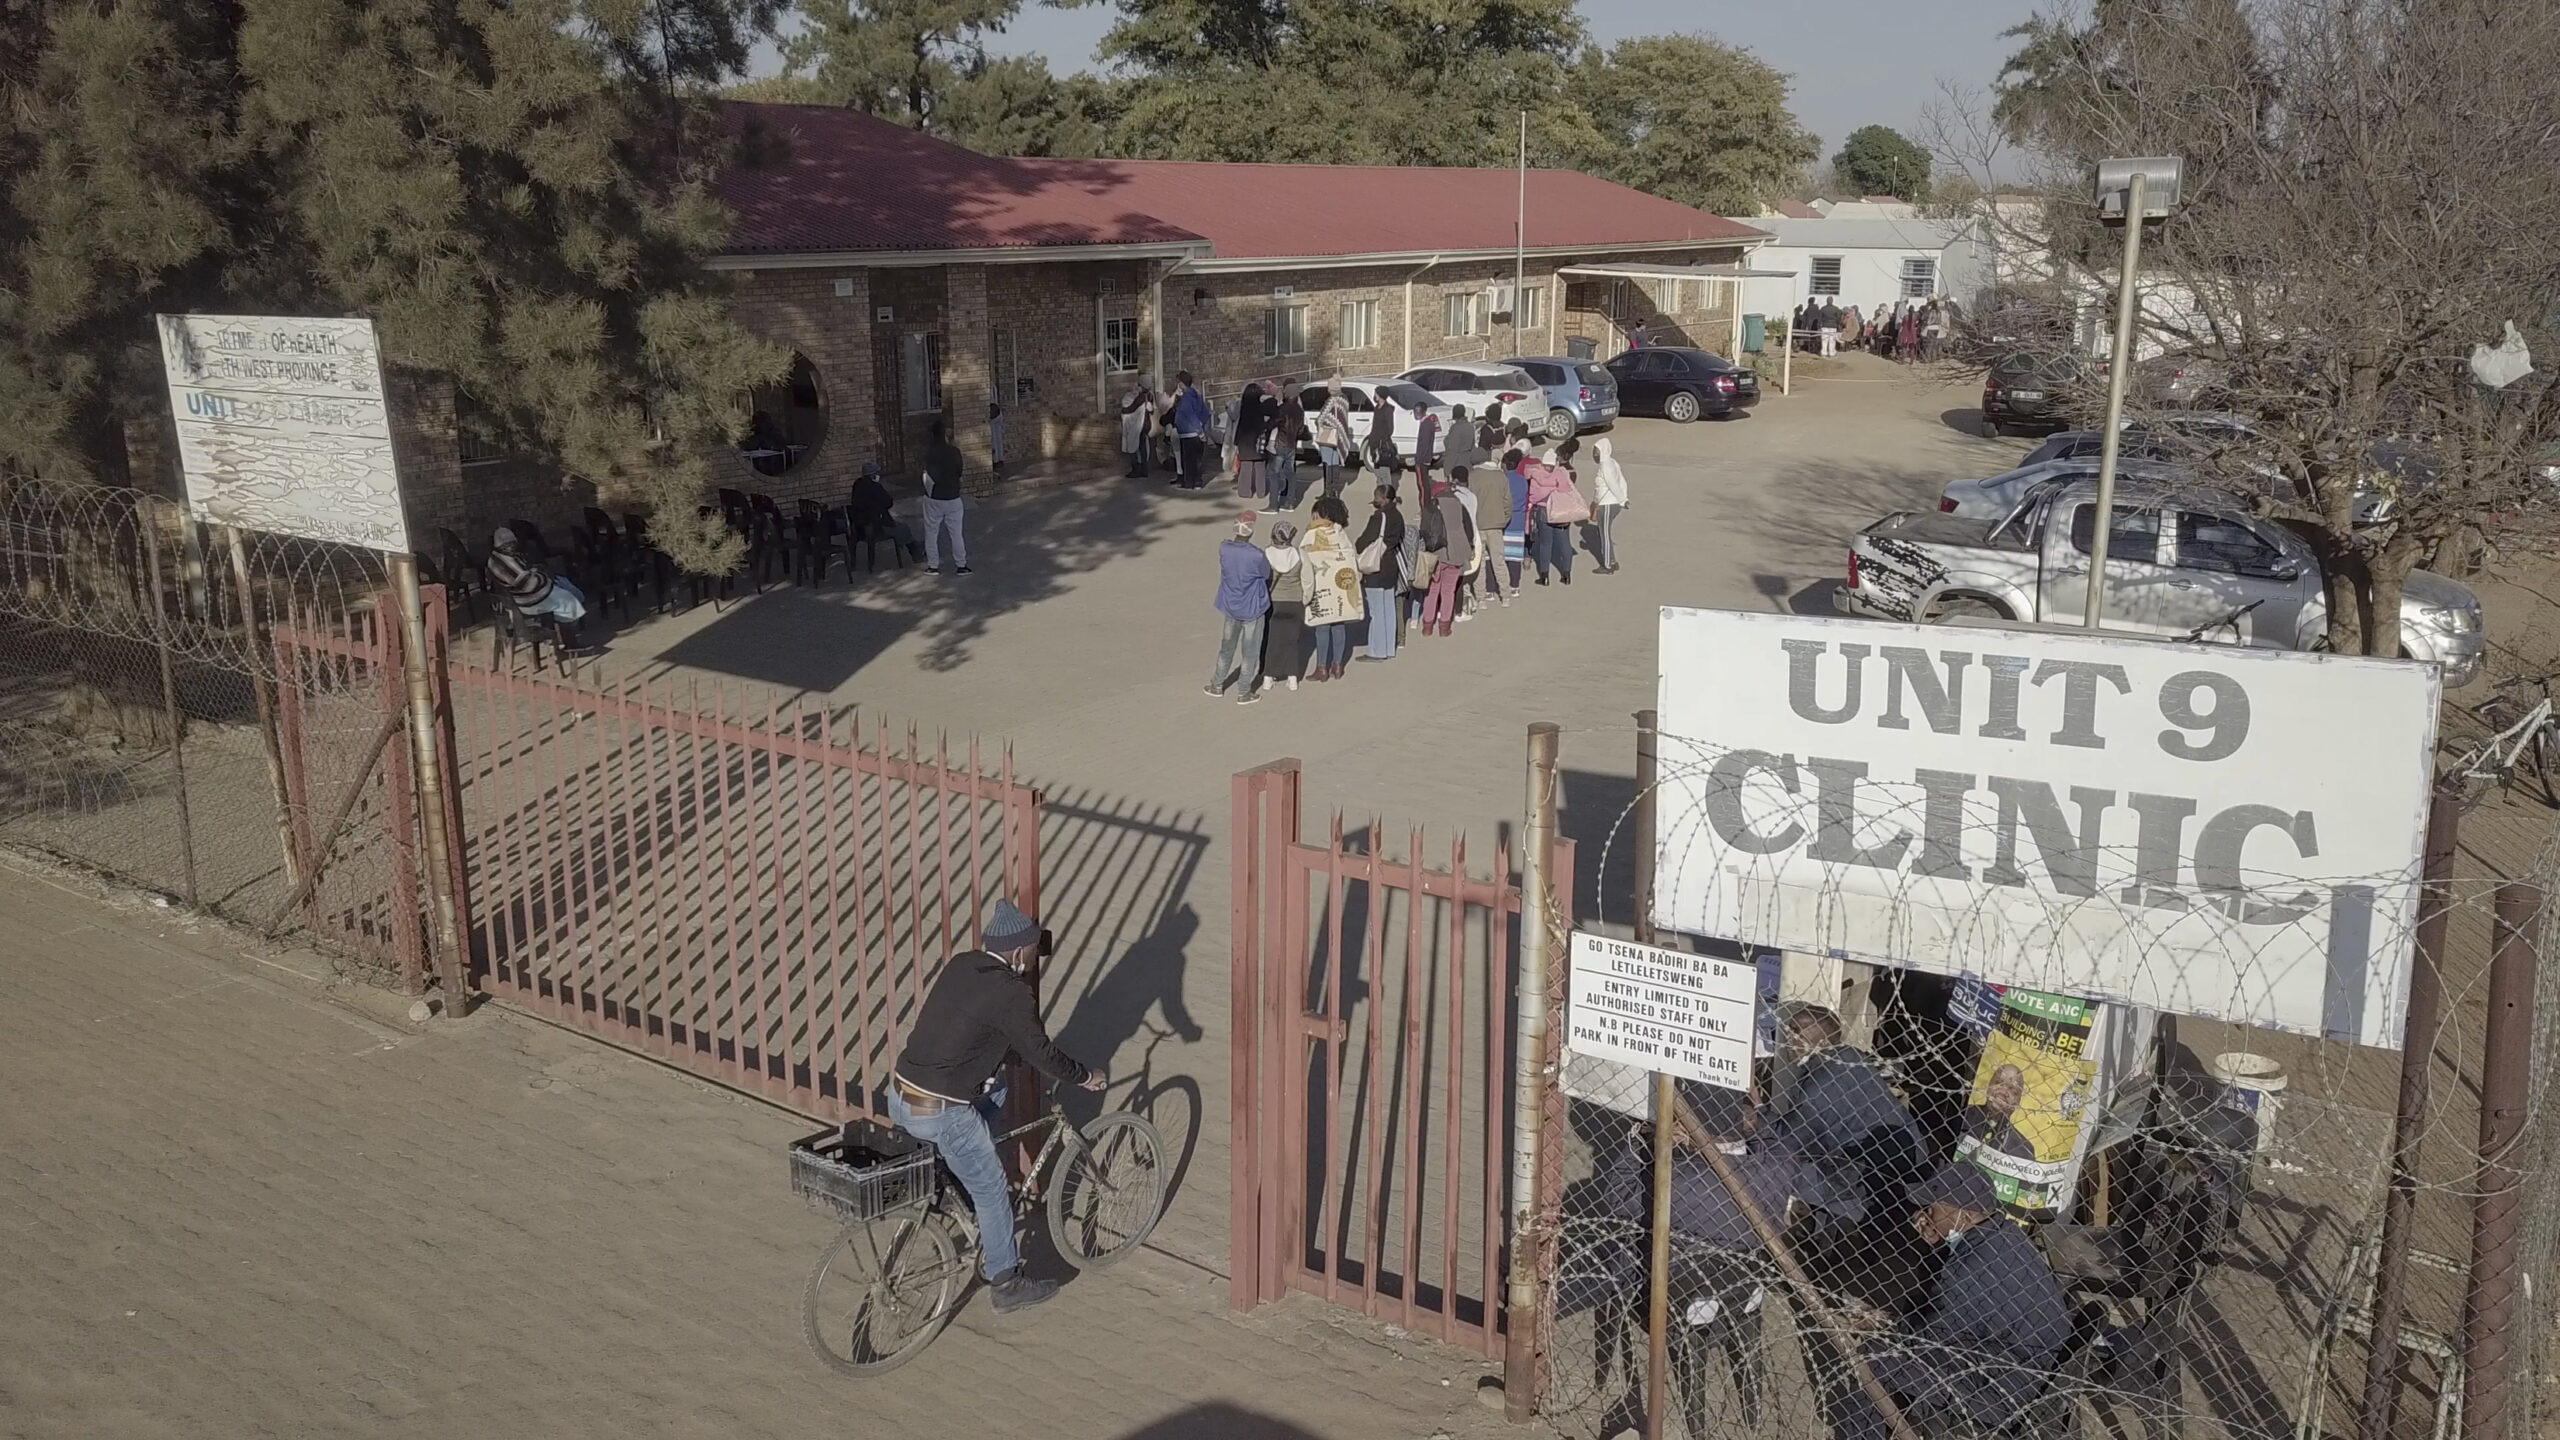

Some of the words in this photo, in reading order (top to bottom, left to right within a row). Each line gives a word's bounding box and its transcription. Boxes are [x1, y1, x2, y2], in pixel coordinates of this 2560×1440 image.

[271, 332, 286, 351] OF
[276, 361, 338, 383] PROVINCE
[1780, 638, 2133, 750] UNIT
[2157, 670, 2251, 762] 9
[1704, 748, 2320, 926] CLINIC
[1589, 939, 1603, 953] GO
[1608, 943, 1644, 961] TSENA
[1649, 951, 1687, 970] BADIRI
[1693, 960, 1708, 974] BA
[1713, 963, 1728, 978] BA
[1611, 959, 1703, 989] LETLELETSWENG
[1604, 980, 1640, 998] ENTRY
[1645, 988, 1689, 1009] LIMITED
[1694, 999, 1709, 1013] TO
[2008, 988, 2045, 1011] VOTE
[2049, 1001, 2080, 1017] ANC
[1586, 992, 1655, 1017] AUTHORISED
[1660, 1008, 1694, 1025] STAFF
[1699, 1016, 1727, 1033] ONLY
[2000, 1011, 2045, 1041] BUILDING
[1599, 1015, 1617, 1030] N.B
[1622, 1021, 1663, 1041] PLEASE
[1669, 1031, 1683, 1045] DO
[1689, 1036, 1711, 1051] NOT
[2009, 1028, 2040, 1049] WARD
[1574, 1026, 1602, 1043] PARK
[1607, 1033, 1618, 1046] IN
[1624, 1037, 1659, 1055] FRONT
[1664, 1046, 1677, 1059] OF
[1683, 1050, 1703, 1066] THE
[1709, 1056, 1738, 1073] GATE
[1698, 1070, 1721, 1083] Thank
